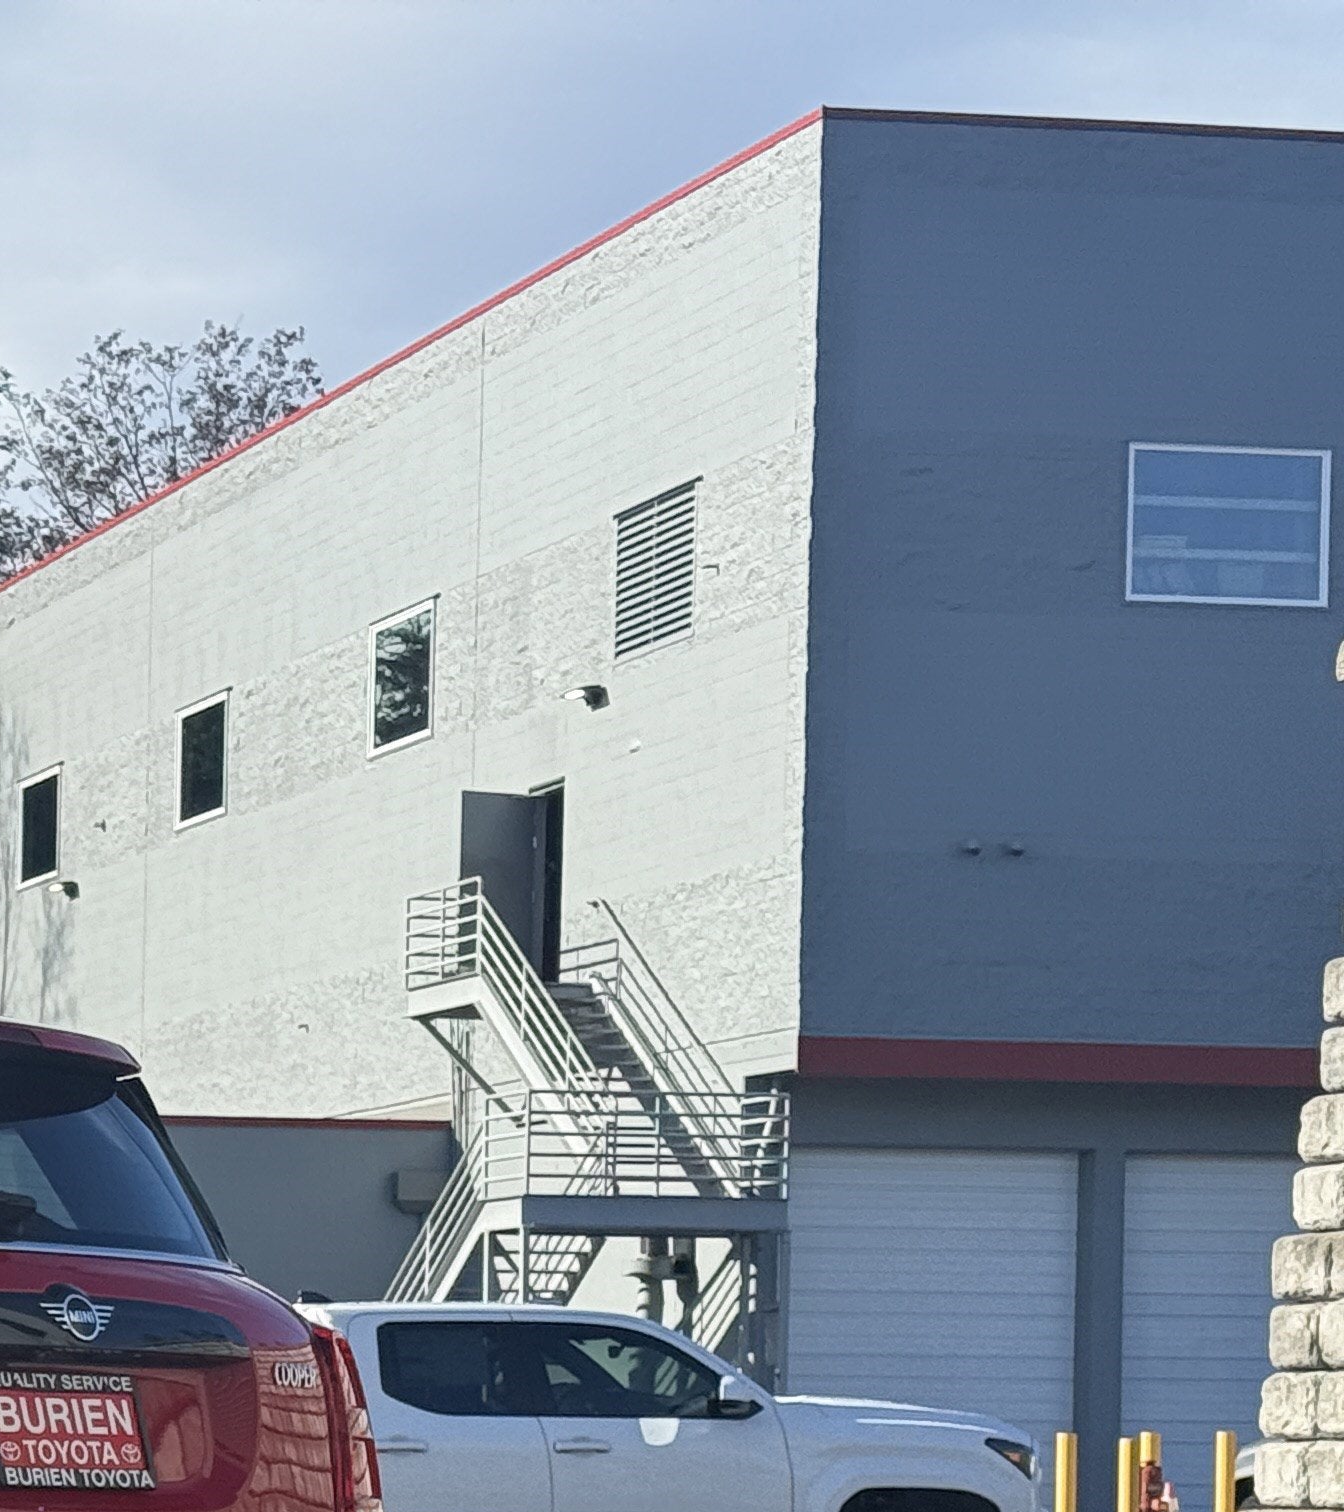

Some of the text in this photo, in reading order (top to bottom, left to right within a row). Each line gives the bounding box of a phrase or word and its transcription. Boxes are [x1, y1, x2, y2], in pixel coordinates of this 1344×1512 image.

[61, 1374, 133, 1392] SERVICE
[273, 1362, 317, 1390] COOPER
[21, 1439, 120, 1465] TOYOTA
[5, 1467, 156, 1488] BURIEN TOYOTA
